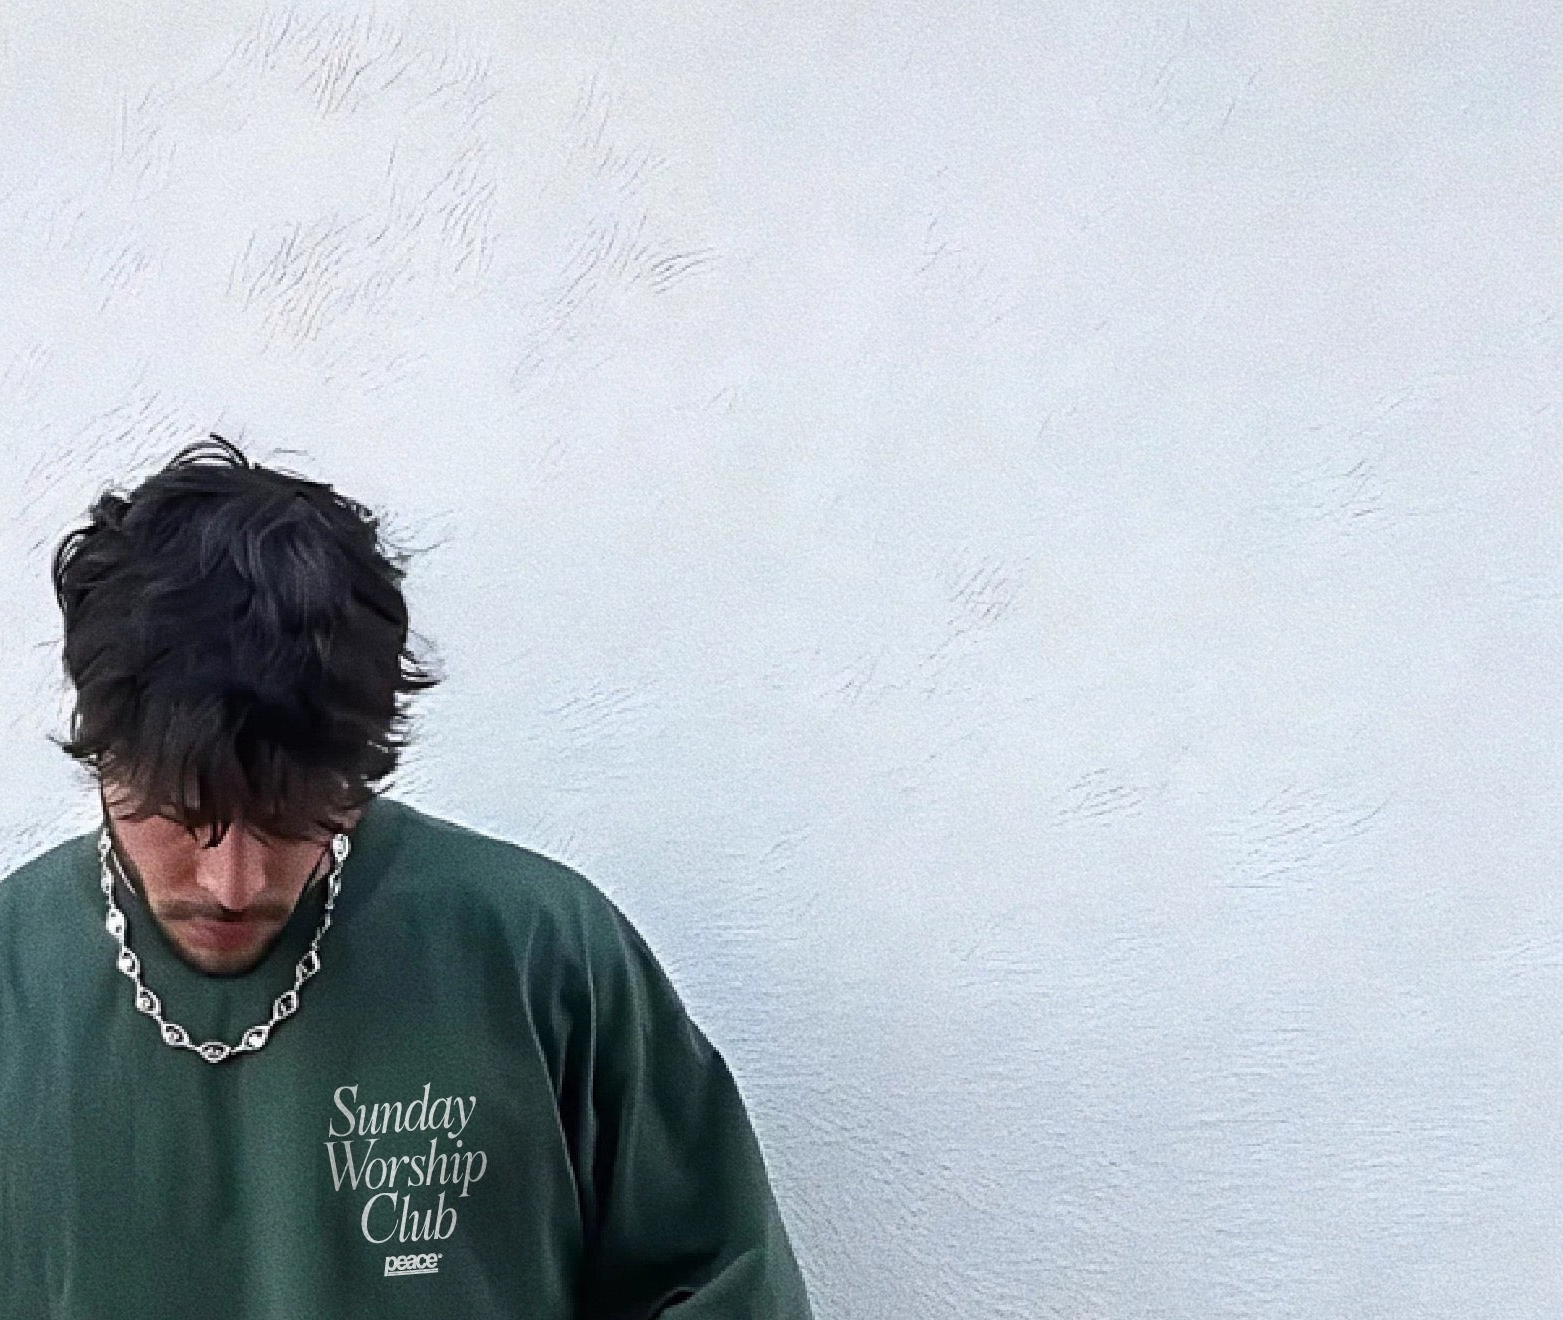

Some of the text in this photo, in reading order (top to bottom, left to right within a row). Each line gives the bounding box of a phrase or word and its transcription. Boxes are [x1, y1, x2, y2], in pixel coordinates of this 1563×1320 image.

[328, 1082, 477, 1139] Sunday
[323, 1136, 488, 1198] Worship
[360, 1190, 458, 1244] Club
